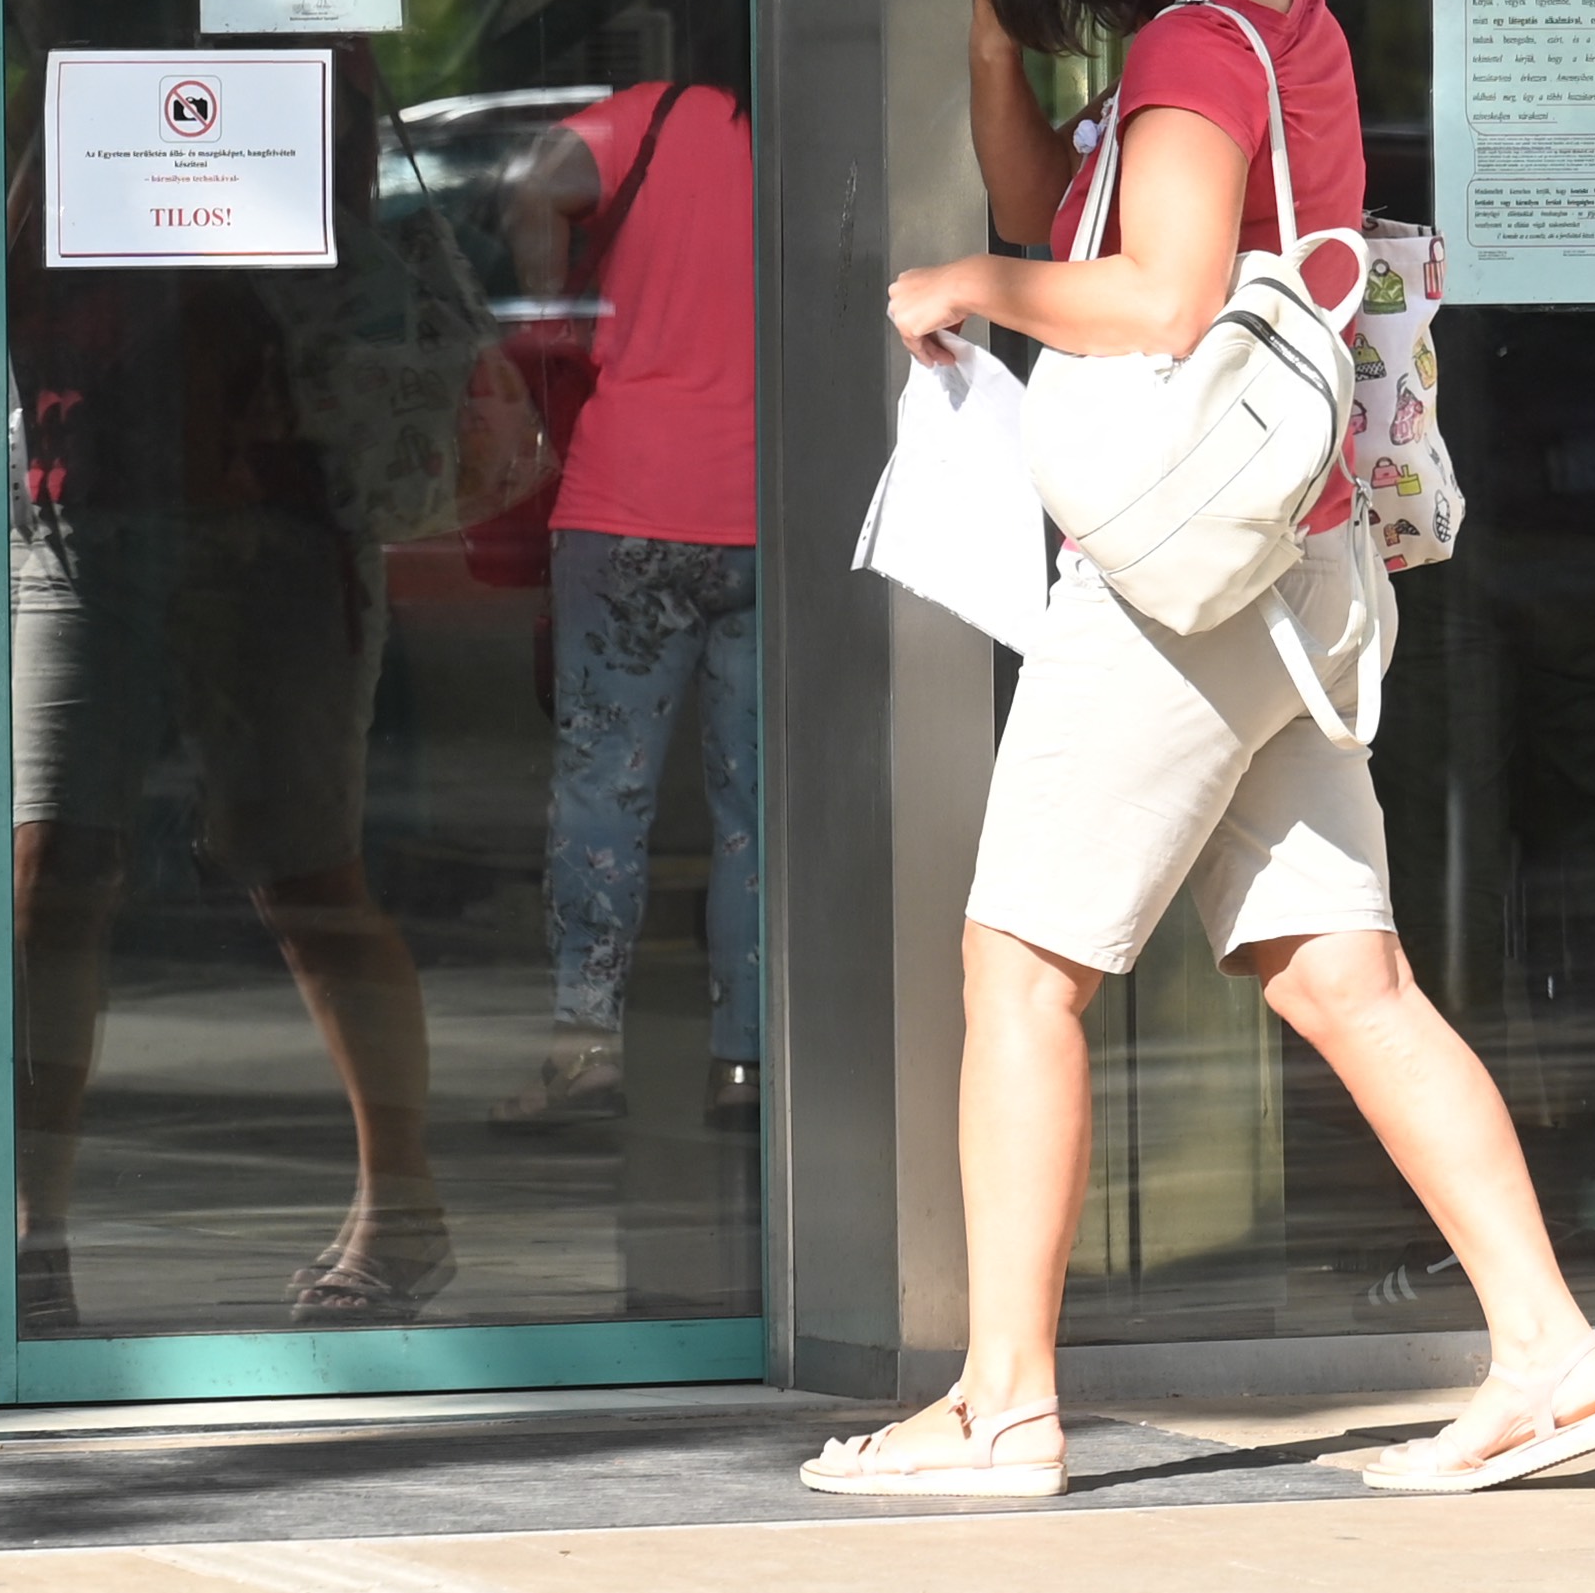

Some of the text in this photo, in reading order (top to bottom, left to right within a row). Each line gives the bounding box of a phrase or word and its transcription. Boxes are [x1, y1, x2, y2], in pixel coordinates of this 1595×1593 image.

[85, 150, 96, 158] Az
[97, 149, 131, 160] Egyetem
[187, 149, 197, 158] és
[174, 160, 208, 168] készíteni
[149, 207, 231, 227] TILOS!
